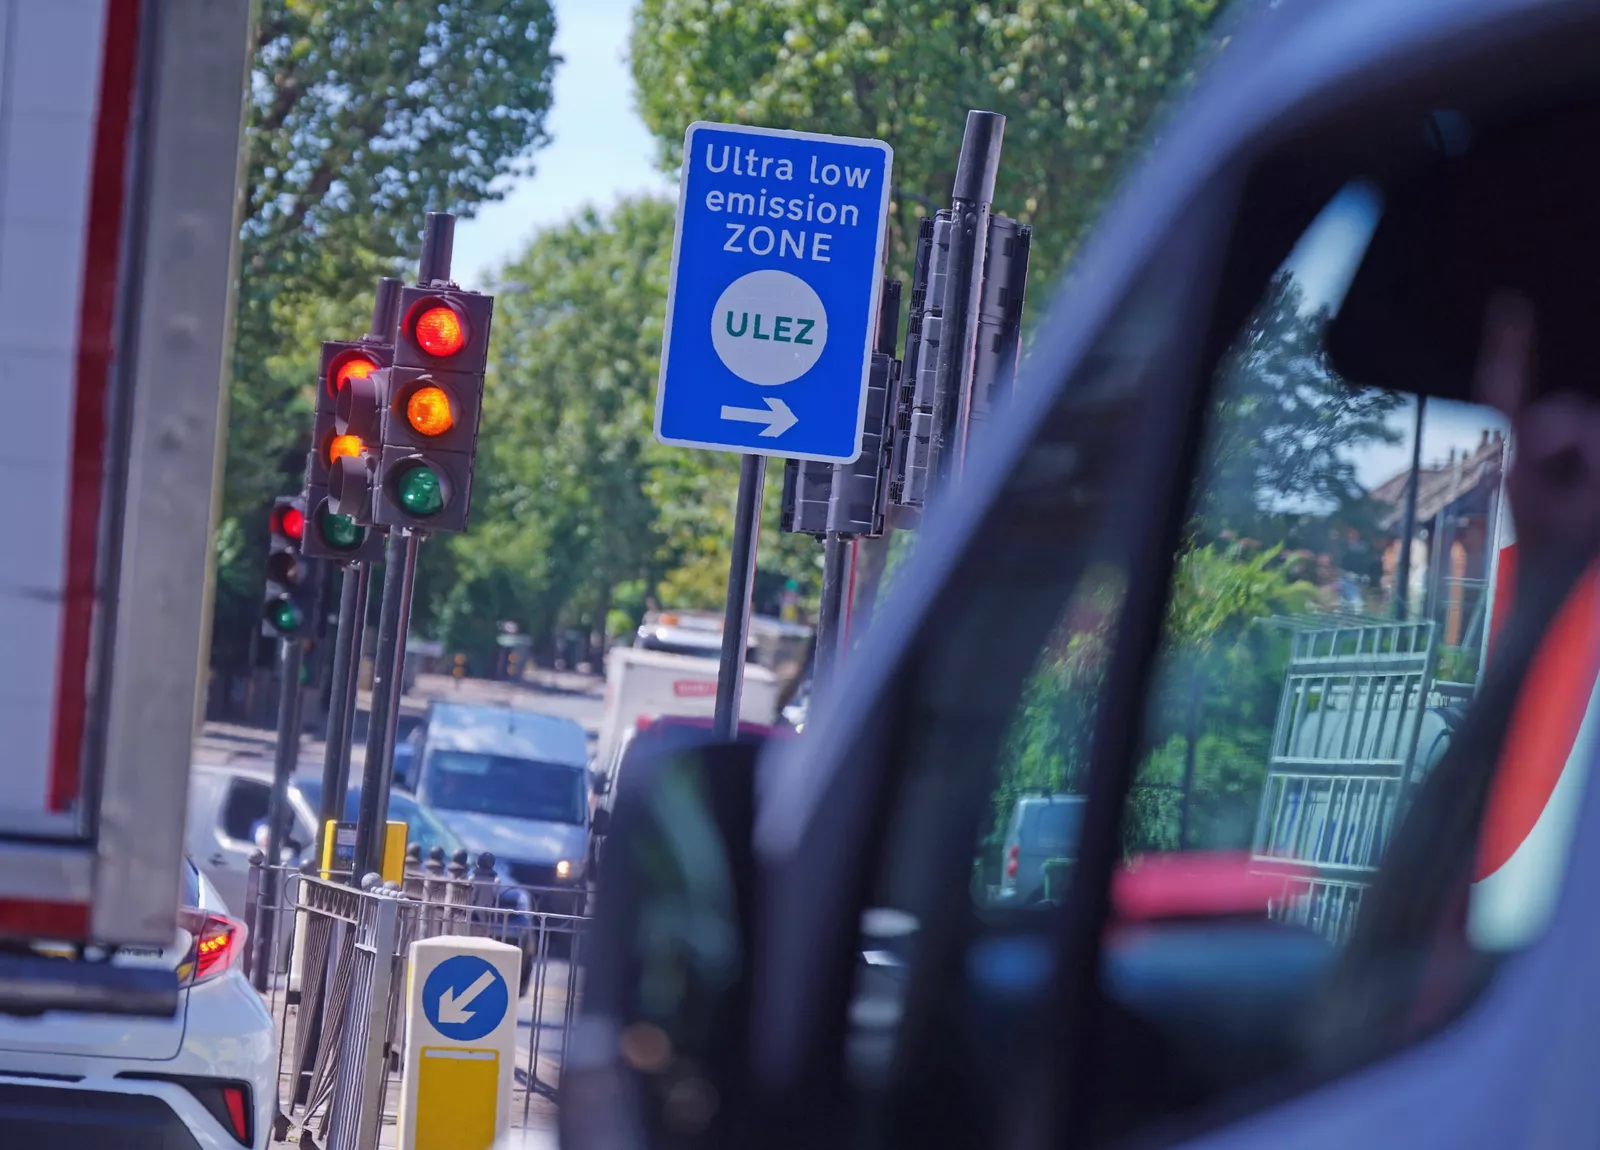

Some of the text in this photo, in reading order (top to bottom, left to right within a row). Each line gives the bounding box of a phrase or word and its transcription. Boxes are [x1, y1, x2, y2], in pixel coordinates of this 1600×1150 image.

[706, 143, 870, 188] Ultra low
[705, 189, 859, 226] emission
[723, 223, 832, 262] ZONE
[725, 310, 815, 345] ULEZ
